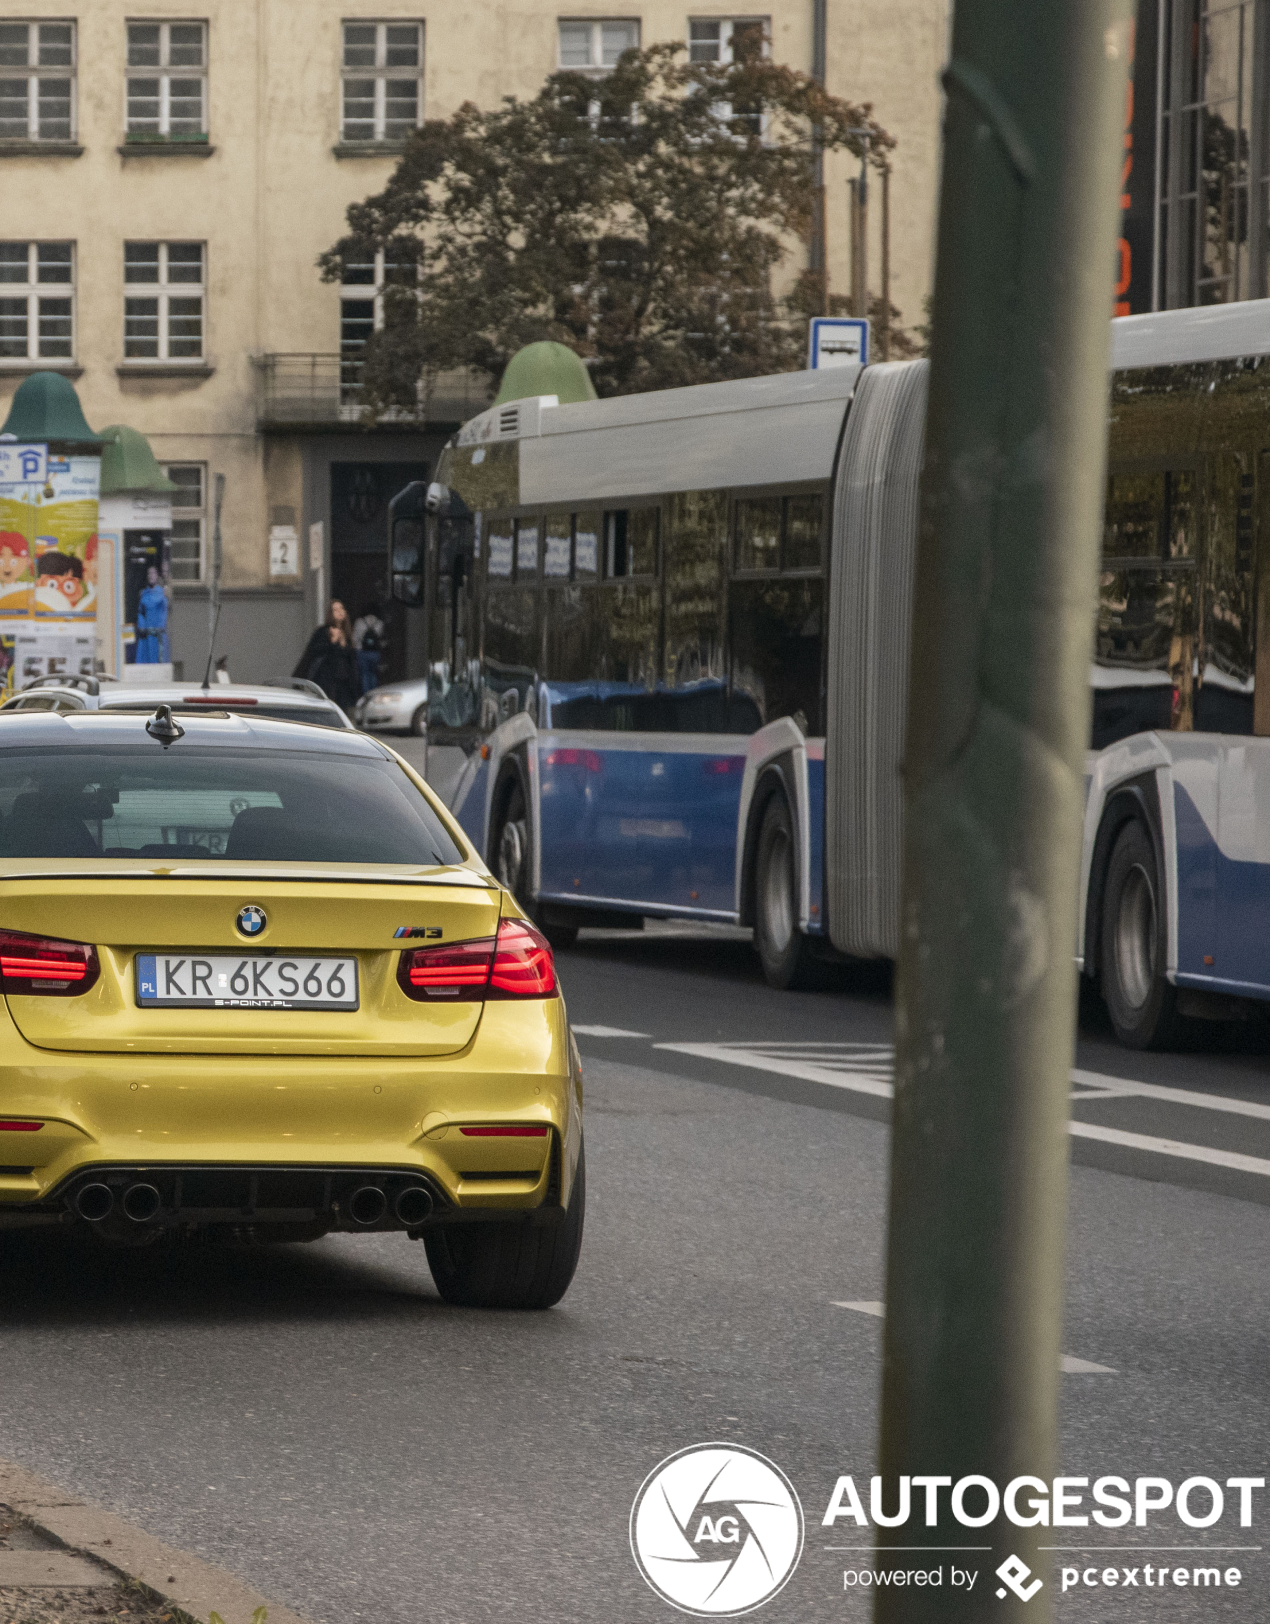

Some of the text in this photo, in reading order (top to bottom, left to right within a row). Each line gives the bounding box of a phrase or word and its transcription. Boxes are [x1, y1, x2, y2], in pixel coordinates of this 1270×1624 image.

[409, 926, 443, 939] M3
[141, 960, 346, 999] PL KR 6KS66
